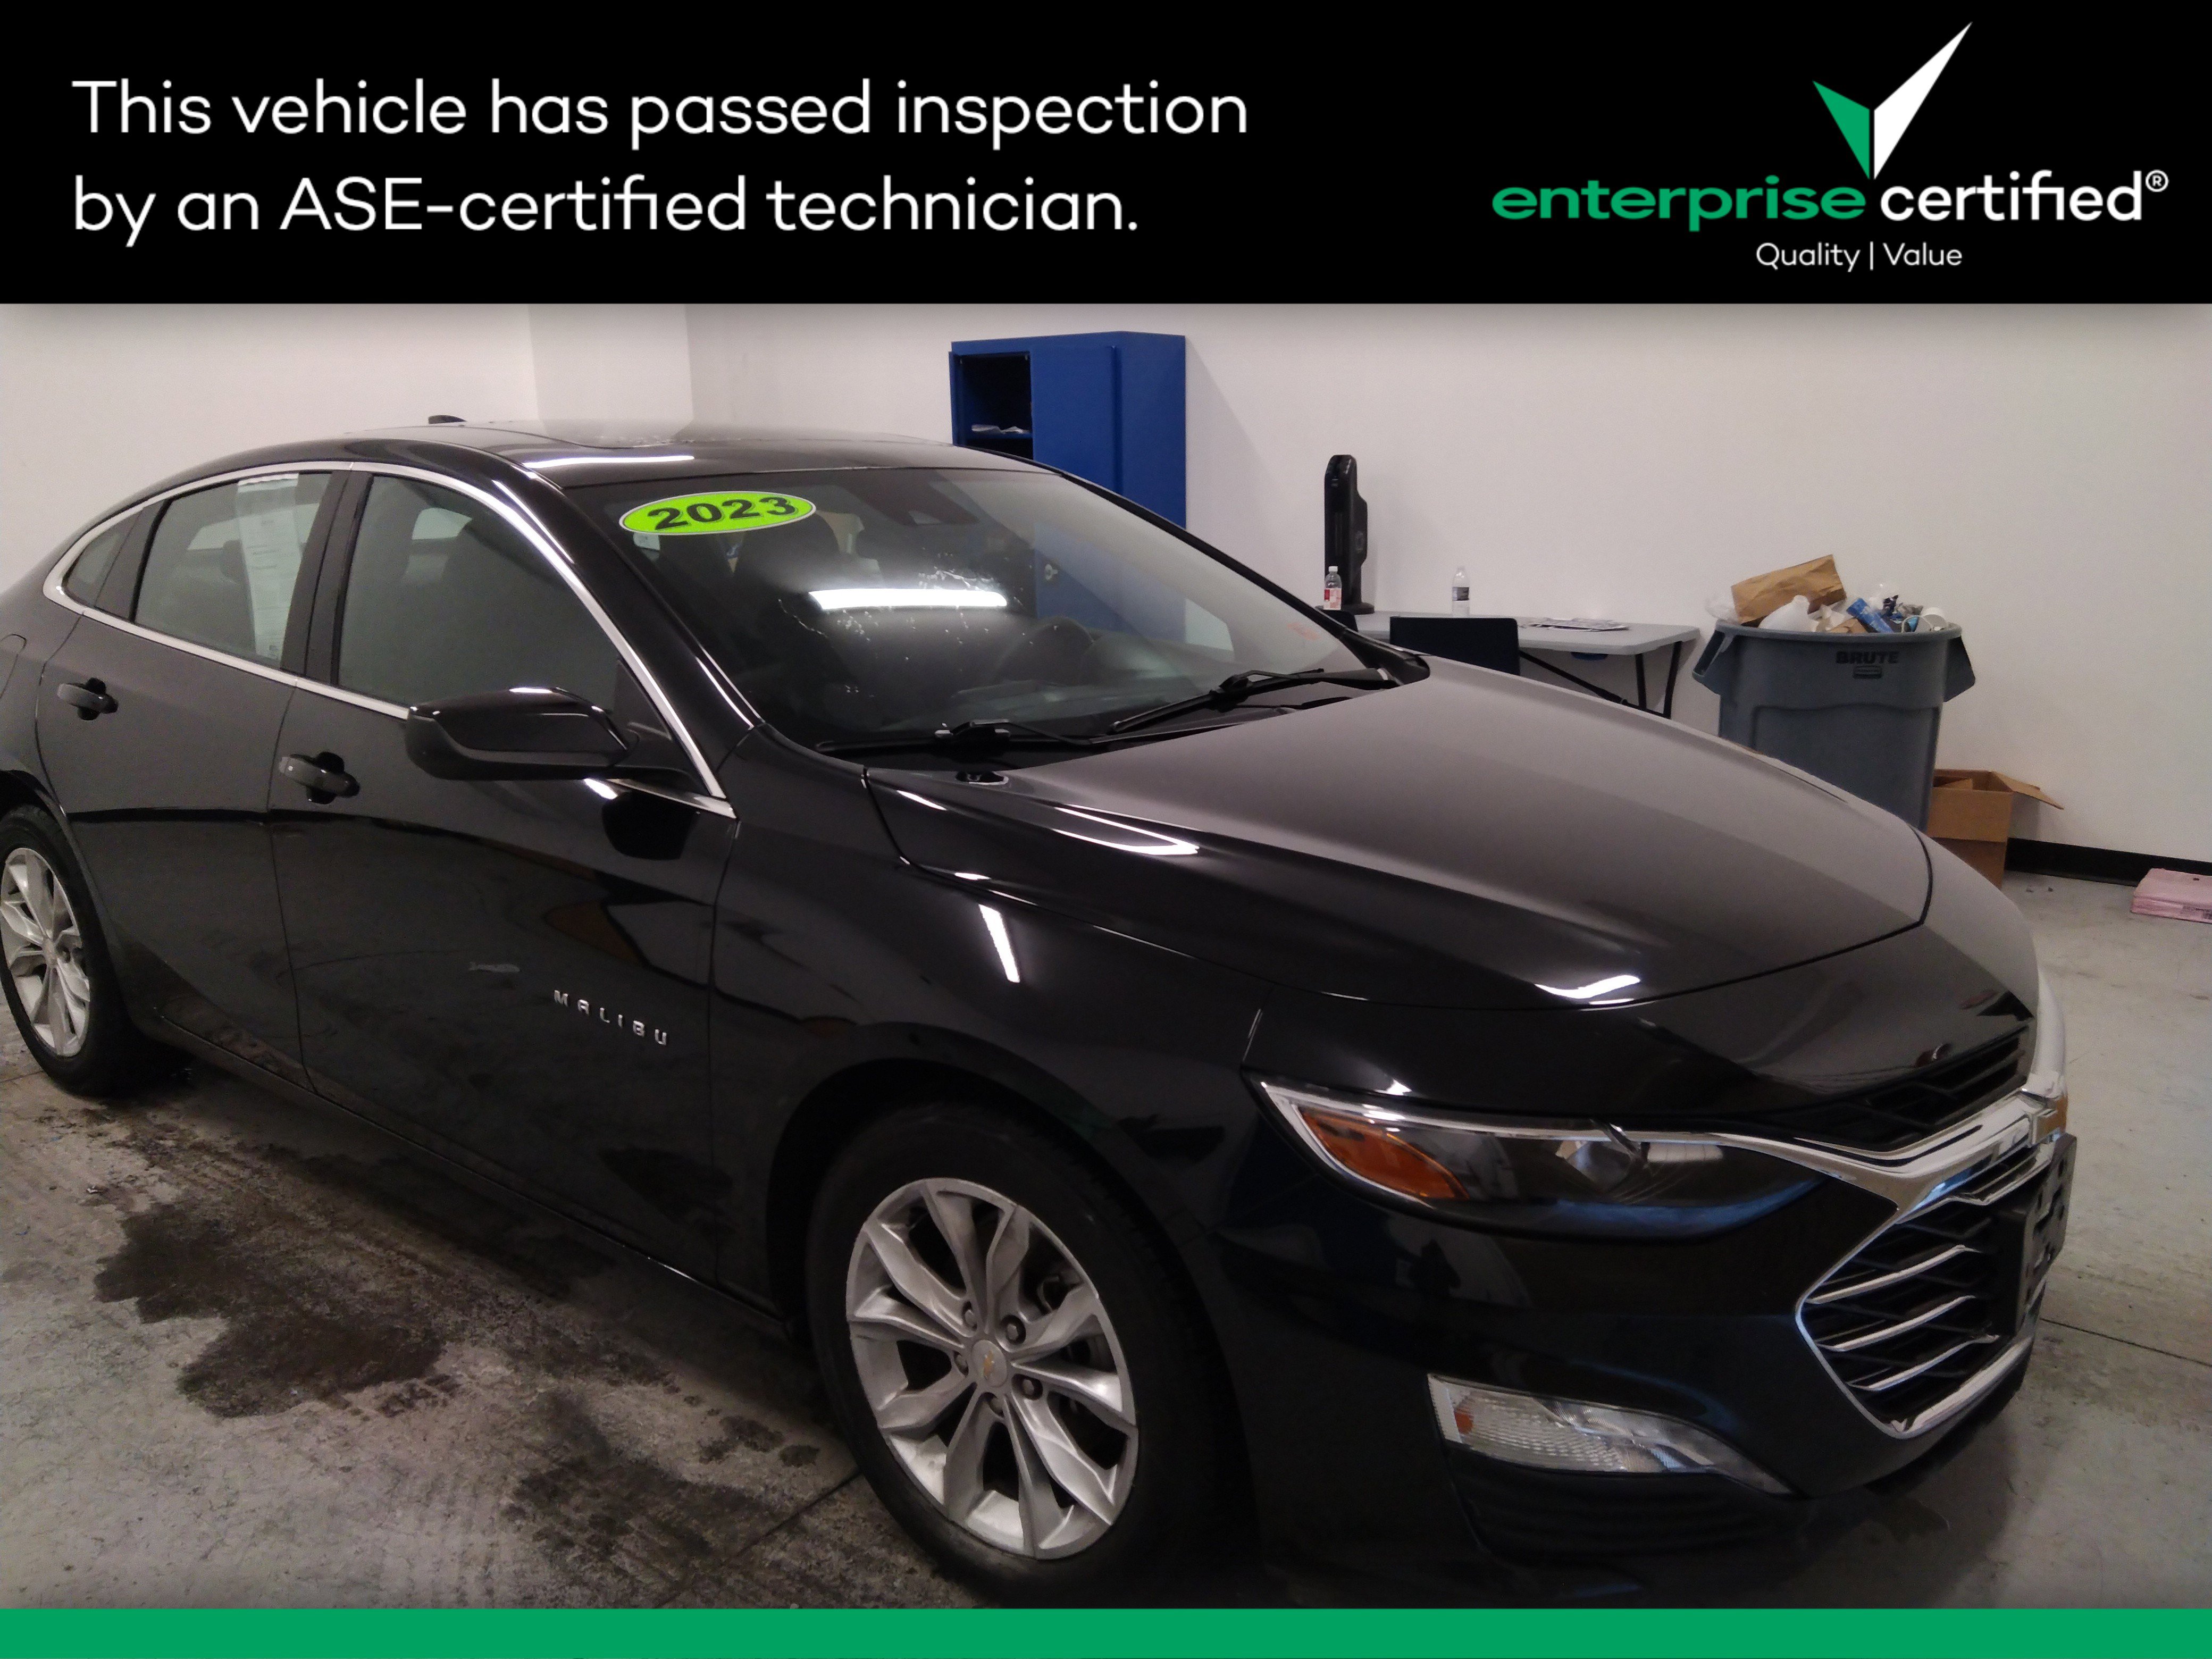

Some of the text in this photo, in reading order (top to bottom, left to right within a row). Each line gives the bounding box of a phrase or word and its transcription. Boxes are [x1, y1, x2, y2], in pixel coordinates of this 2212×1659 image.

[647, 496, 797, 531] 2023
[1836, 651, 1899, 664] BRUTE
[554, 990, 667, 1045] MALIBU
